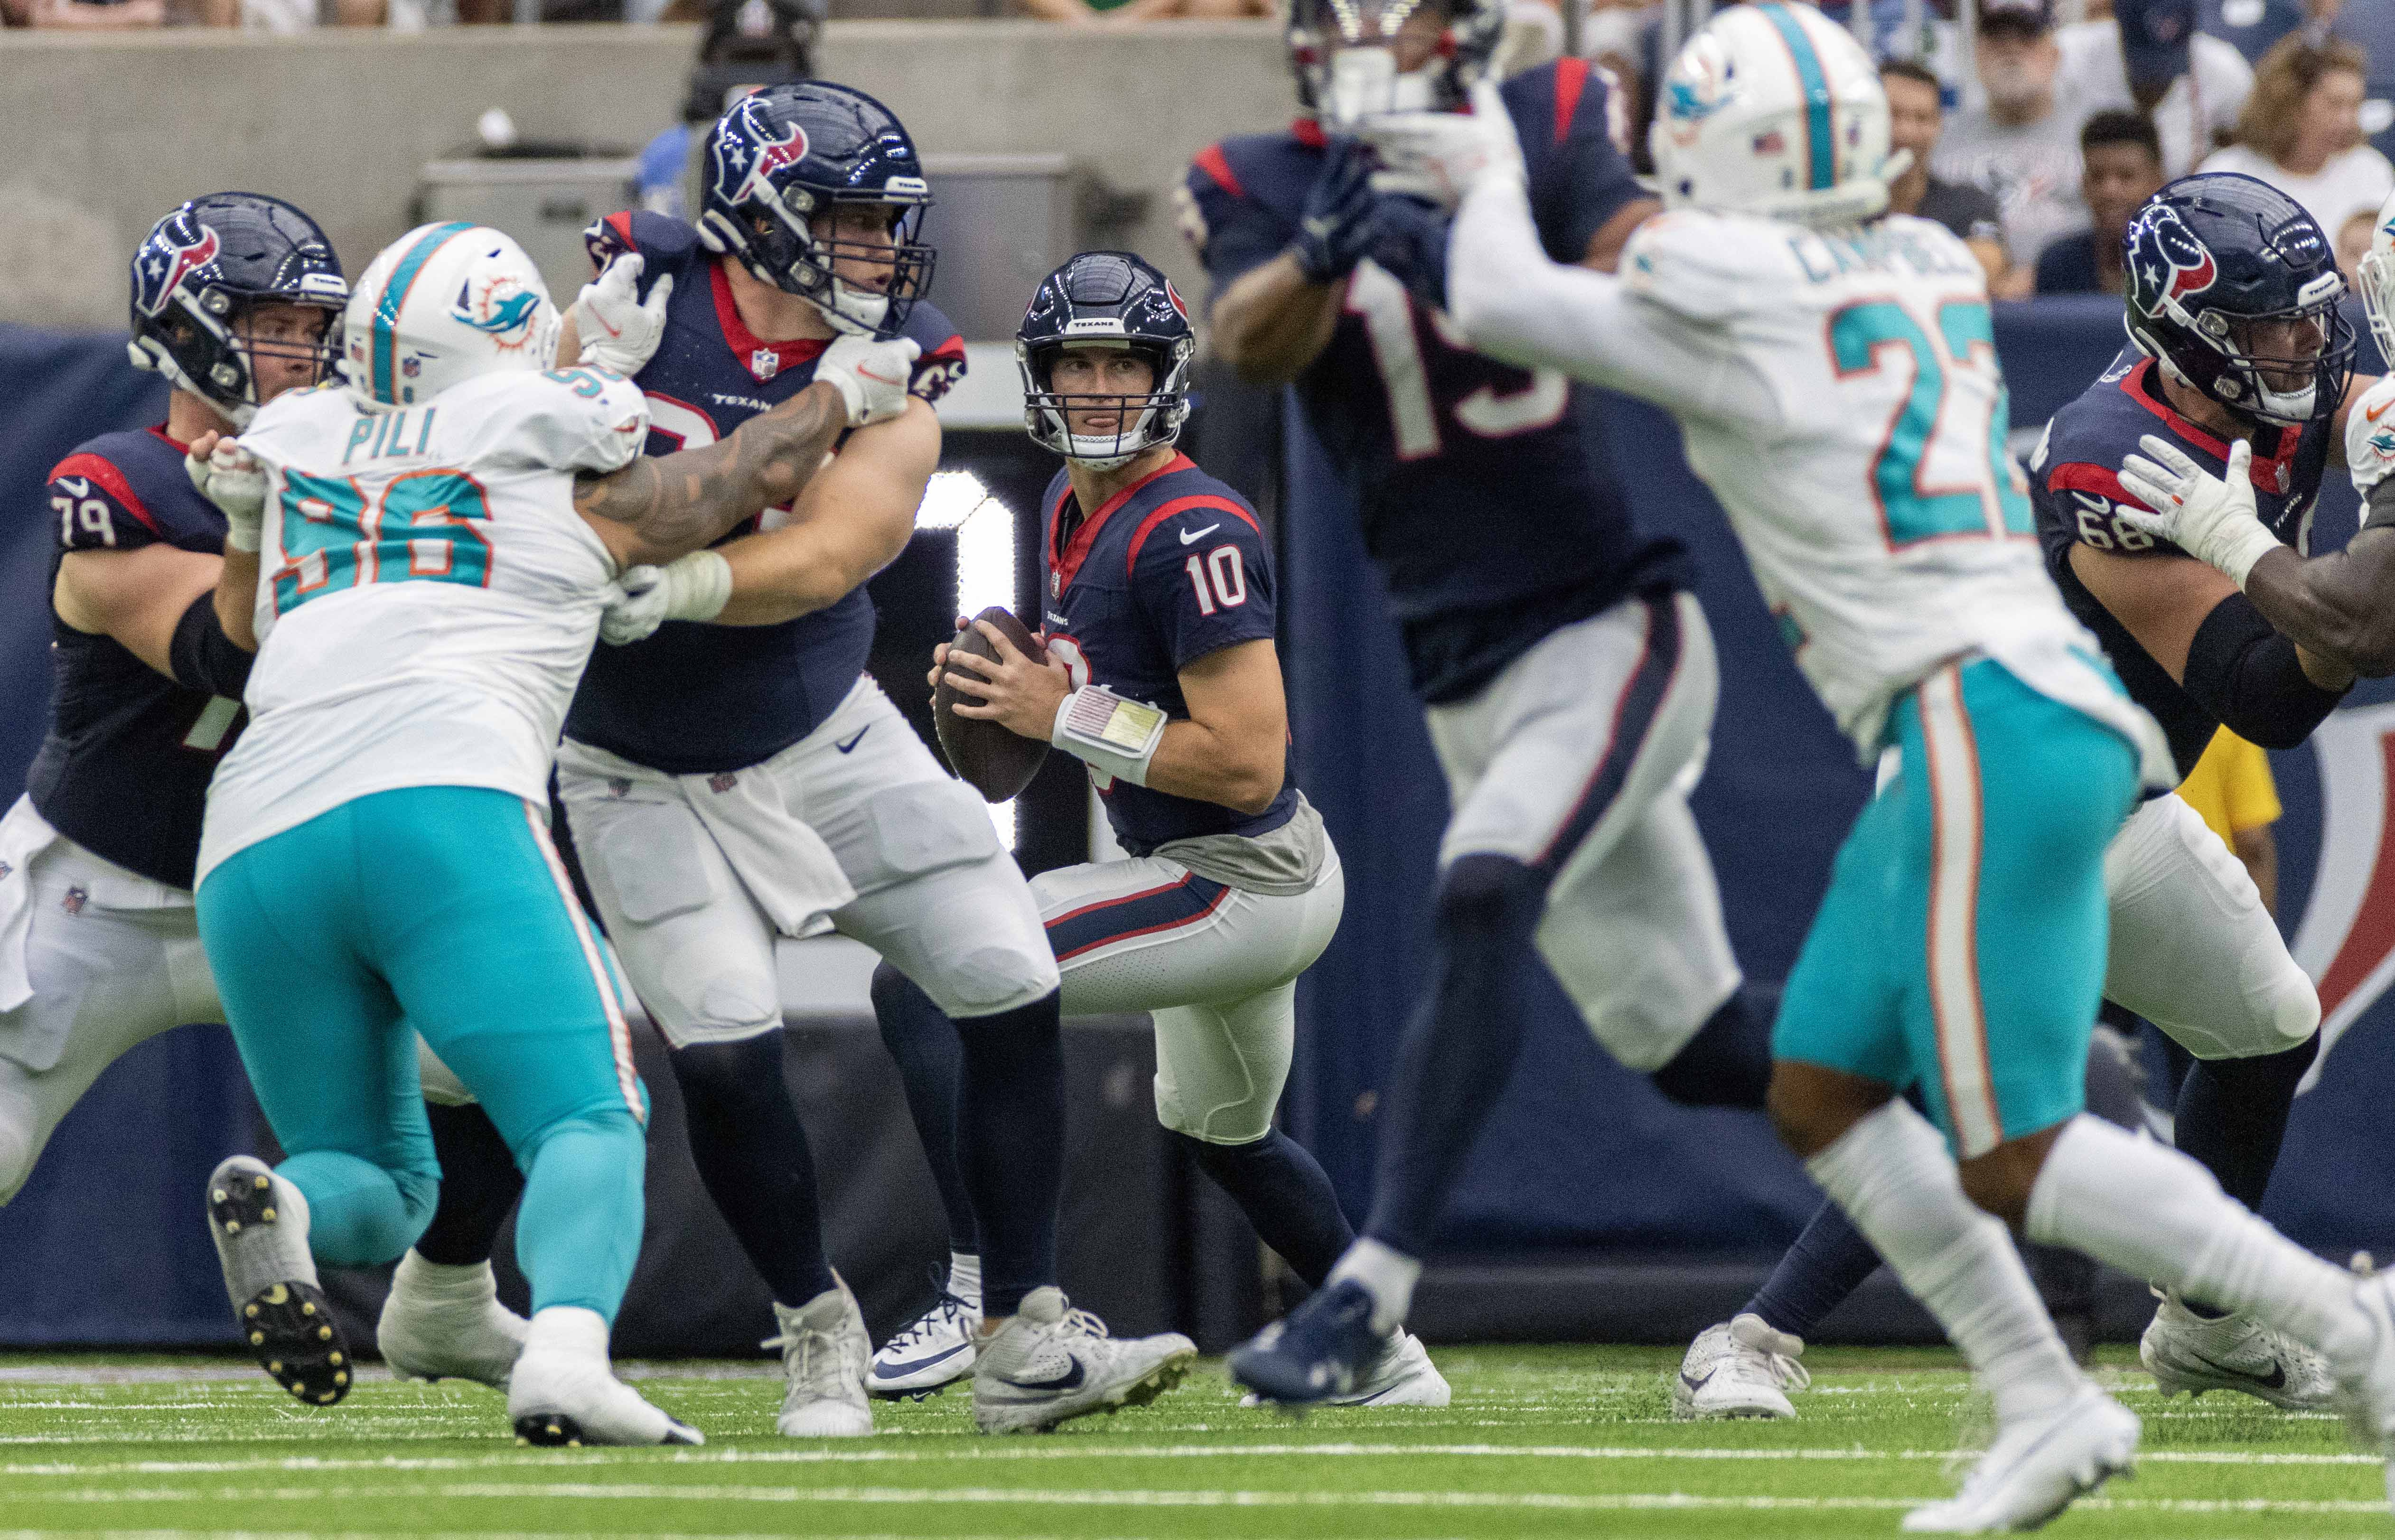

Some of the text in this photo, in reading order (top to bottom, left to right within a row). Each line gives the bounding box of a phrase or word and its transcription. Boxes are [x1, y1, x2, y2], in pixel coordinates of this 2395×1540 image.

[712, 393, 772, 412] TEXAN
[1823, 293, 2041, 554] 22
[342, 406, 437, 465] PILI
[51, 496, 119, 547] 79
[271, 467, 493, 620] 96
[2076, 508, 2154, 551] 68
[1184, 543, 1246, 616] 10
[1047, 610, 1068, 626] TEXANS
